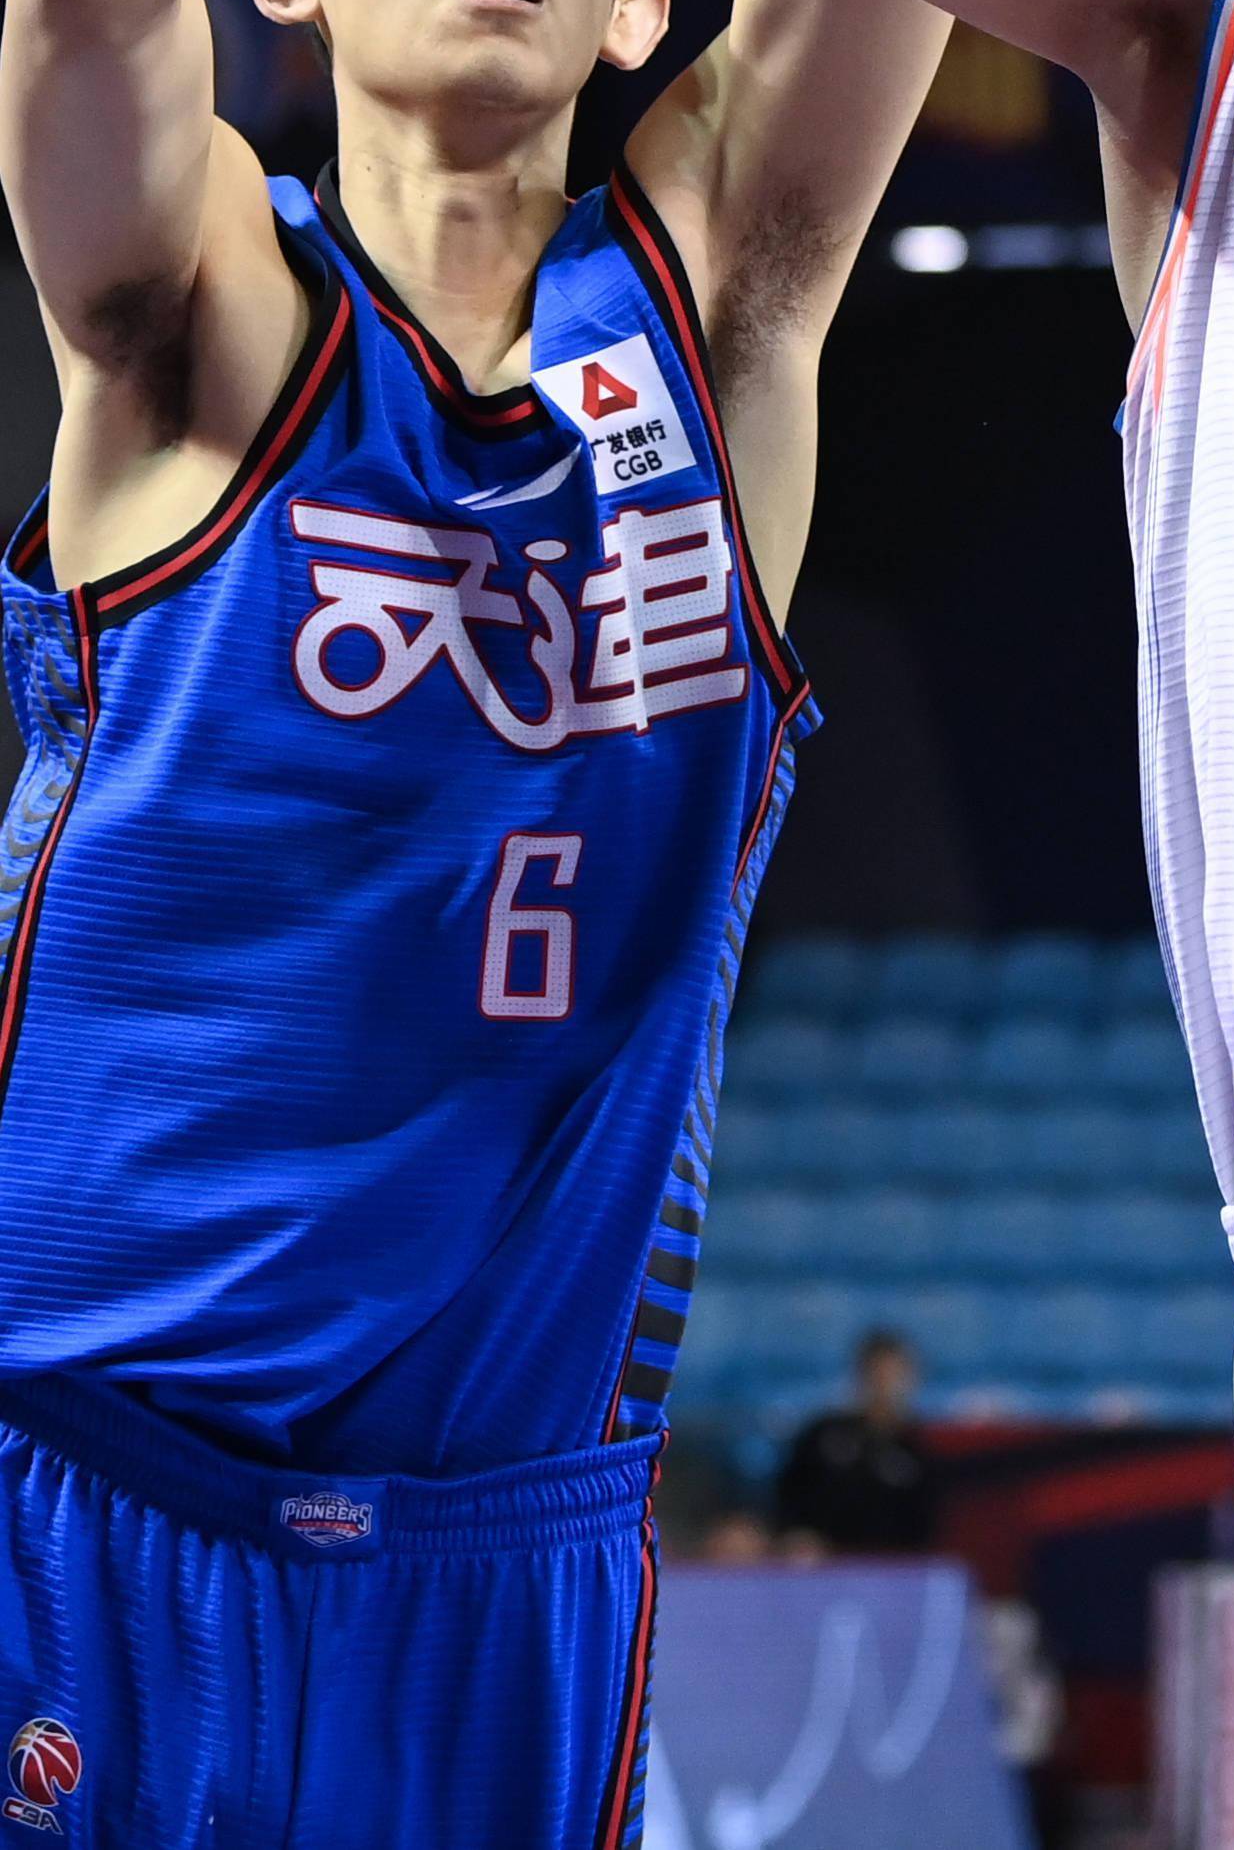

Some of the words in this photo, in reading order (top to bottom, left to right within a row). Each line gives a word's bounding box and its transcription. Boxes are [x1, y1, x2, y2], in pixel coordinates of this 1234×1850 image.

[613, 450, 663, 481] CGB
[477, 831, 583, 1020] 6
[284, 1502, 369, 1532] PIONEERS
[2, 1796, 64, 1836] CBA
